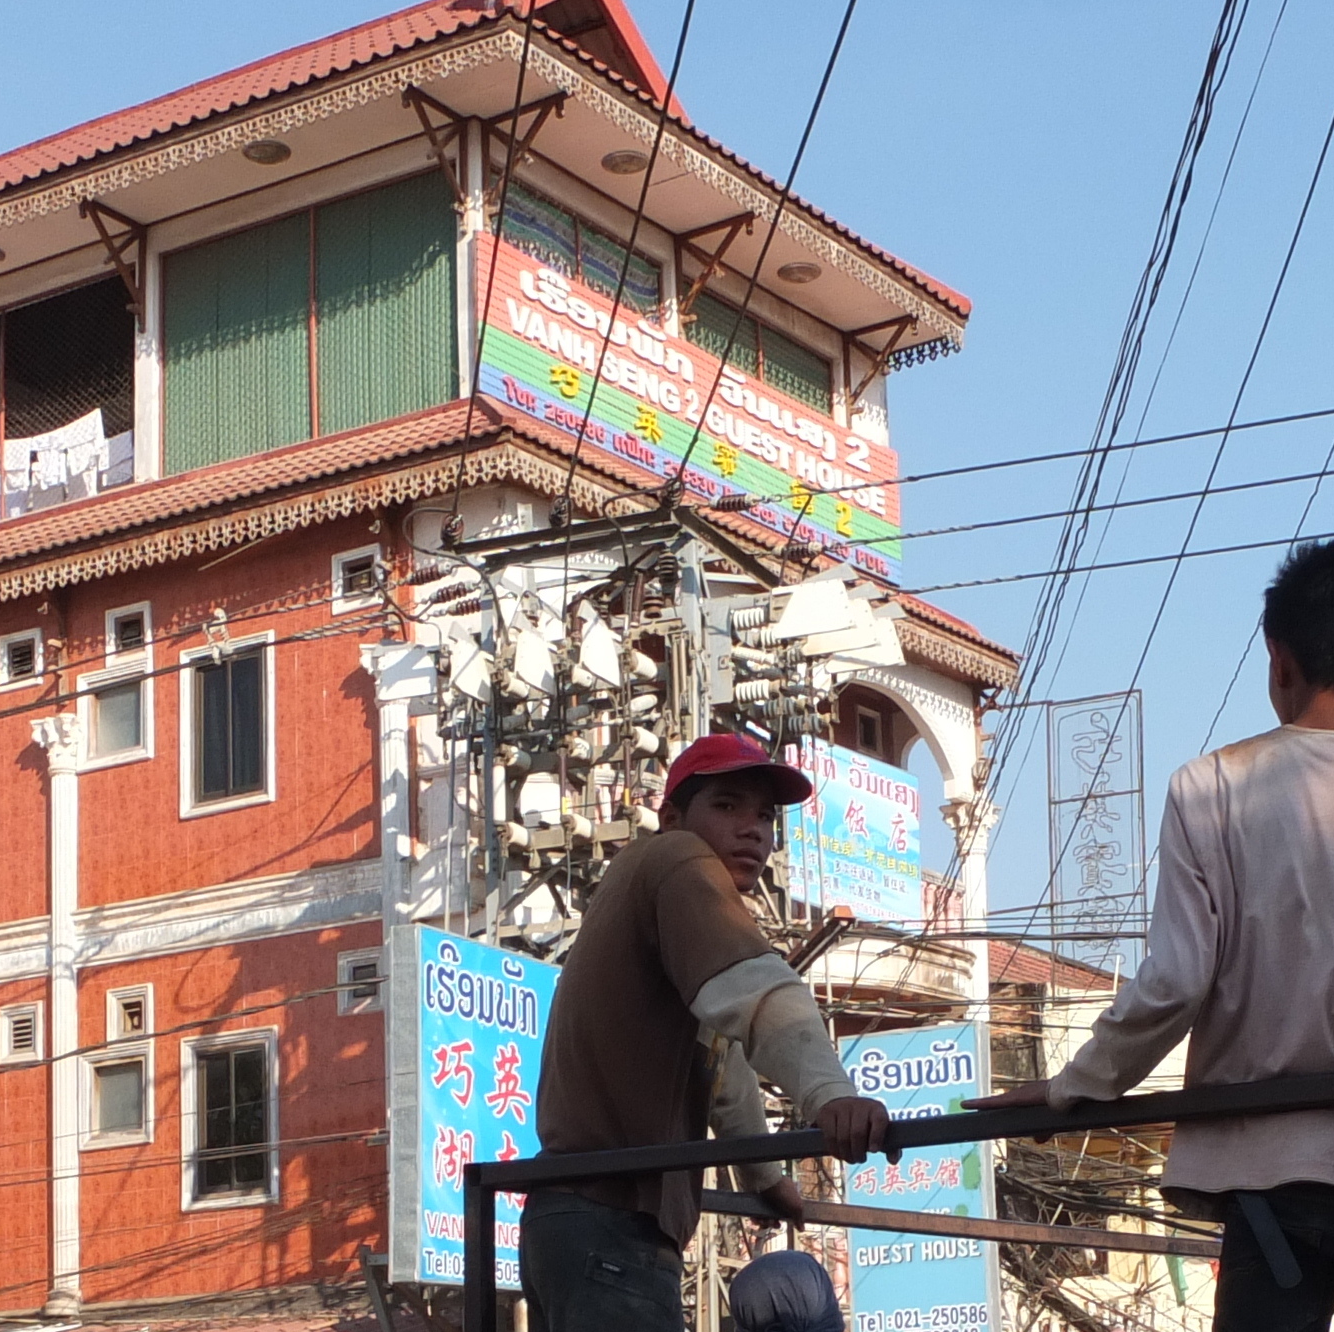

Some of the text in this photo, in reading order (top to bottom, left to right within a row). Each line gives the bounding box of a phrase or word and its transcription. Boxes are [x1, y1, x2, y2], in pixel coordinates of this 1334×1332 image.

[506, 298, 886, 516] VANH SENG 2 GUEST HOUSE
[845, 437, 872, 473] 2
[431, 1041, 530, 1123] 巧英
[854, 1157, 961, 1195] 巧英宾馆
[426, 1212, 465, 1240] VAN
[856, 1238, 982, 1267] GUEST HOUSE
[857, 1304, 988, 1332] Tel:021-250586
